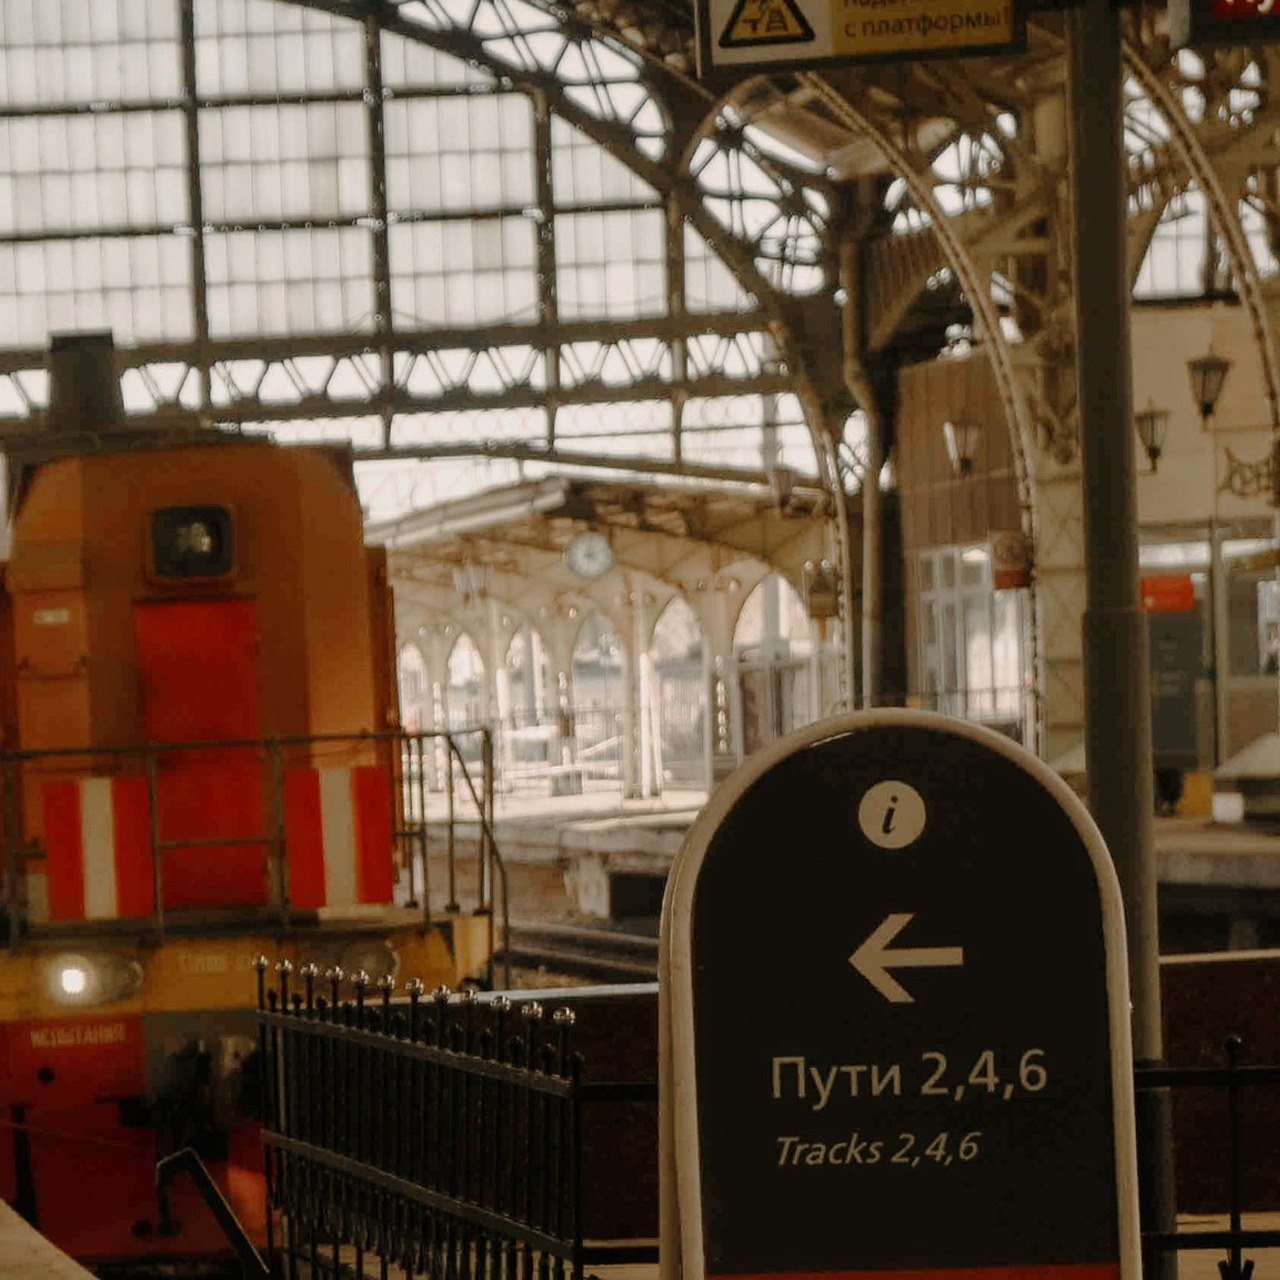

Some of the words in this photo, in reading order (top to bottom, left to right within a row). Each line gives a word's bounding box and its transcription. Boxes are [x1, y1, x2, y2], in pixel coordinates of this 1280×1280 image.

[844, 22, 856, 37] с
[772, 1055, 902, 1111] Пути
[920, 1048, 1048, 1102] 2,4,6
[776, 1131, 885, 1166] Tracks
[890, 1131, 983, 1168] 2,4,6
